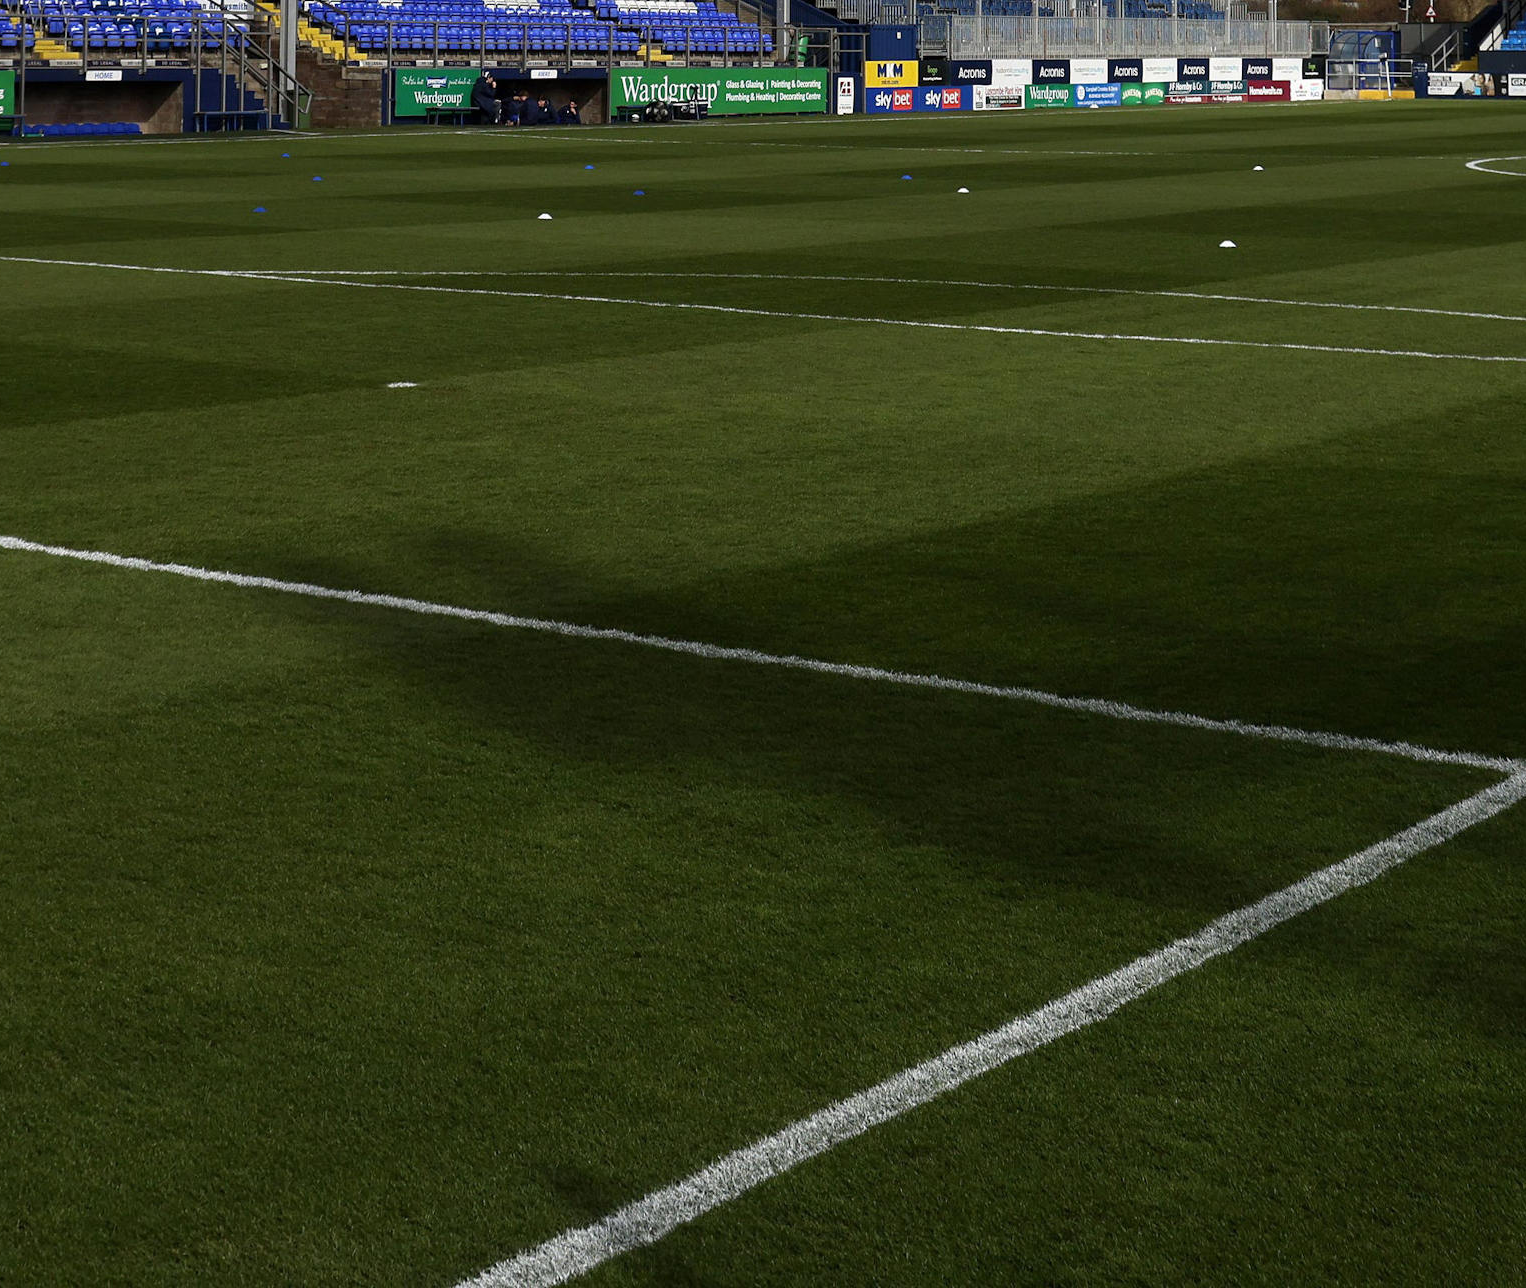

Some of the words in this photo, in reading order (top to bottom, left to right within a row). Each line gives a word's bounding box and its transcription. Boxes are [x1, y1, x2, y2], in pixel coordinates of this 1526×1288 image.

[94, 71, 114, 80] HOME
[877, 63, 903, 78] MKM
[958, 66, 986, 80] Acronis
[1039, 66, 1065, 78] Acronis
[1114, 66, 1139, 77] Acronis
[1182, 64, 1206, 75] Acronis
[1246, 64, 1269, 75] Acronis
[726, 80, 740, 89] Glass
[740, 80, 745, 89] &
[746, 80, 764, 91] Glazing
[771, 80, 791, 91] Painting
[791, 80, 796, 89] &
[797, 80, 821, 91] Decorating
[414, 91, 463, 107] Wardgroup
[726, 92, 749, 103] Plumbing
[749, 92, 755, 101] &
[756, 92, 775, 103] Heating
[779, 92, 804, 103] Decorating
[805, 92, 821, 102] Centre
[925, 89, 941, 108] sky
[944, 90, 959, 104] bet
[1029, 86, 1069, 103] Wardgroup
[1122, 88, 1142, 100] JAMESON
[1145, 87, 1164, 99] JAMESON
[875, 90, 892, 109] sky
[895, 91, 911, 106] bet
